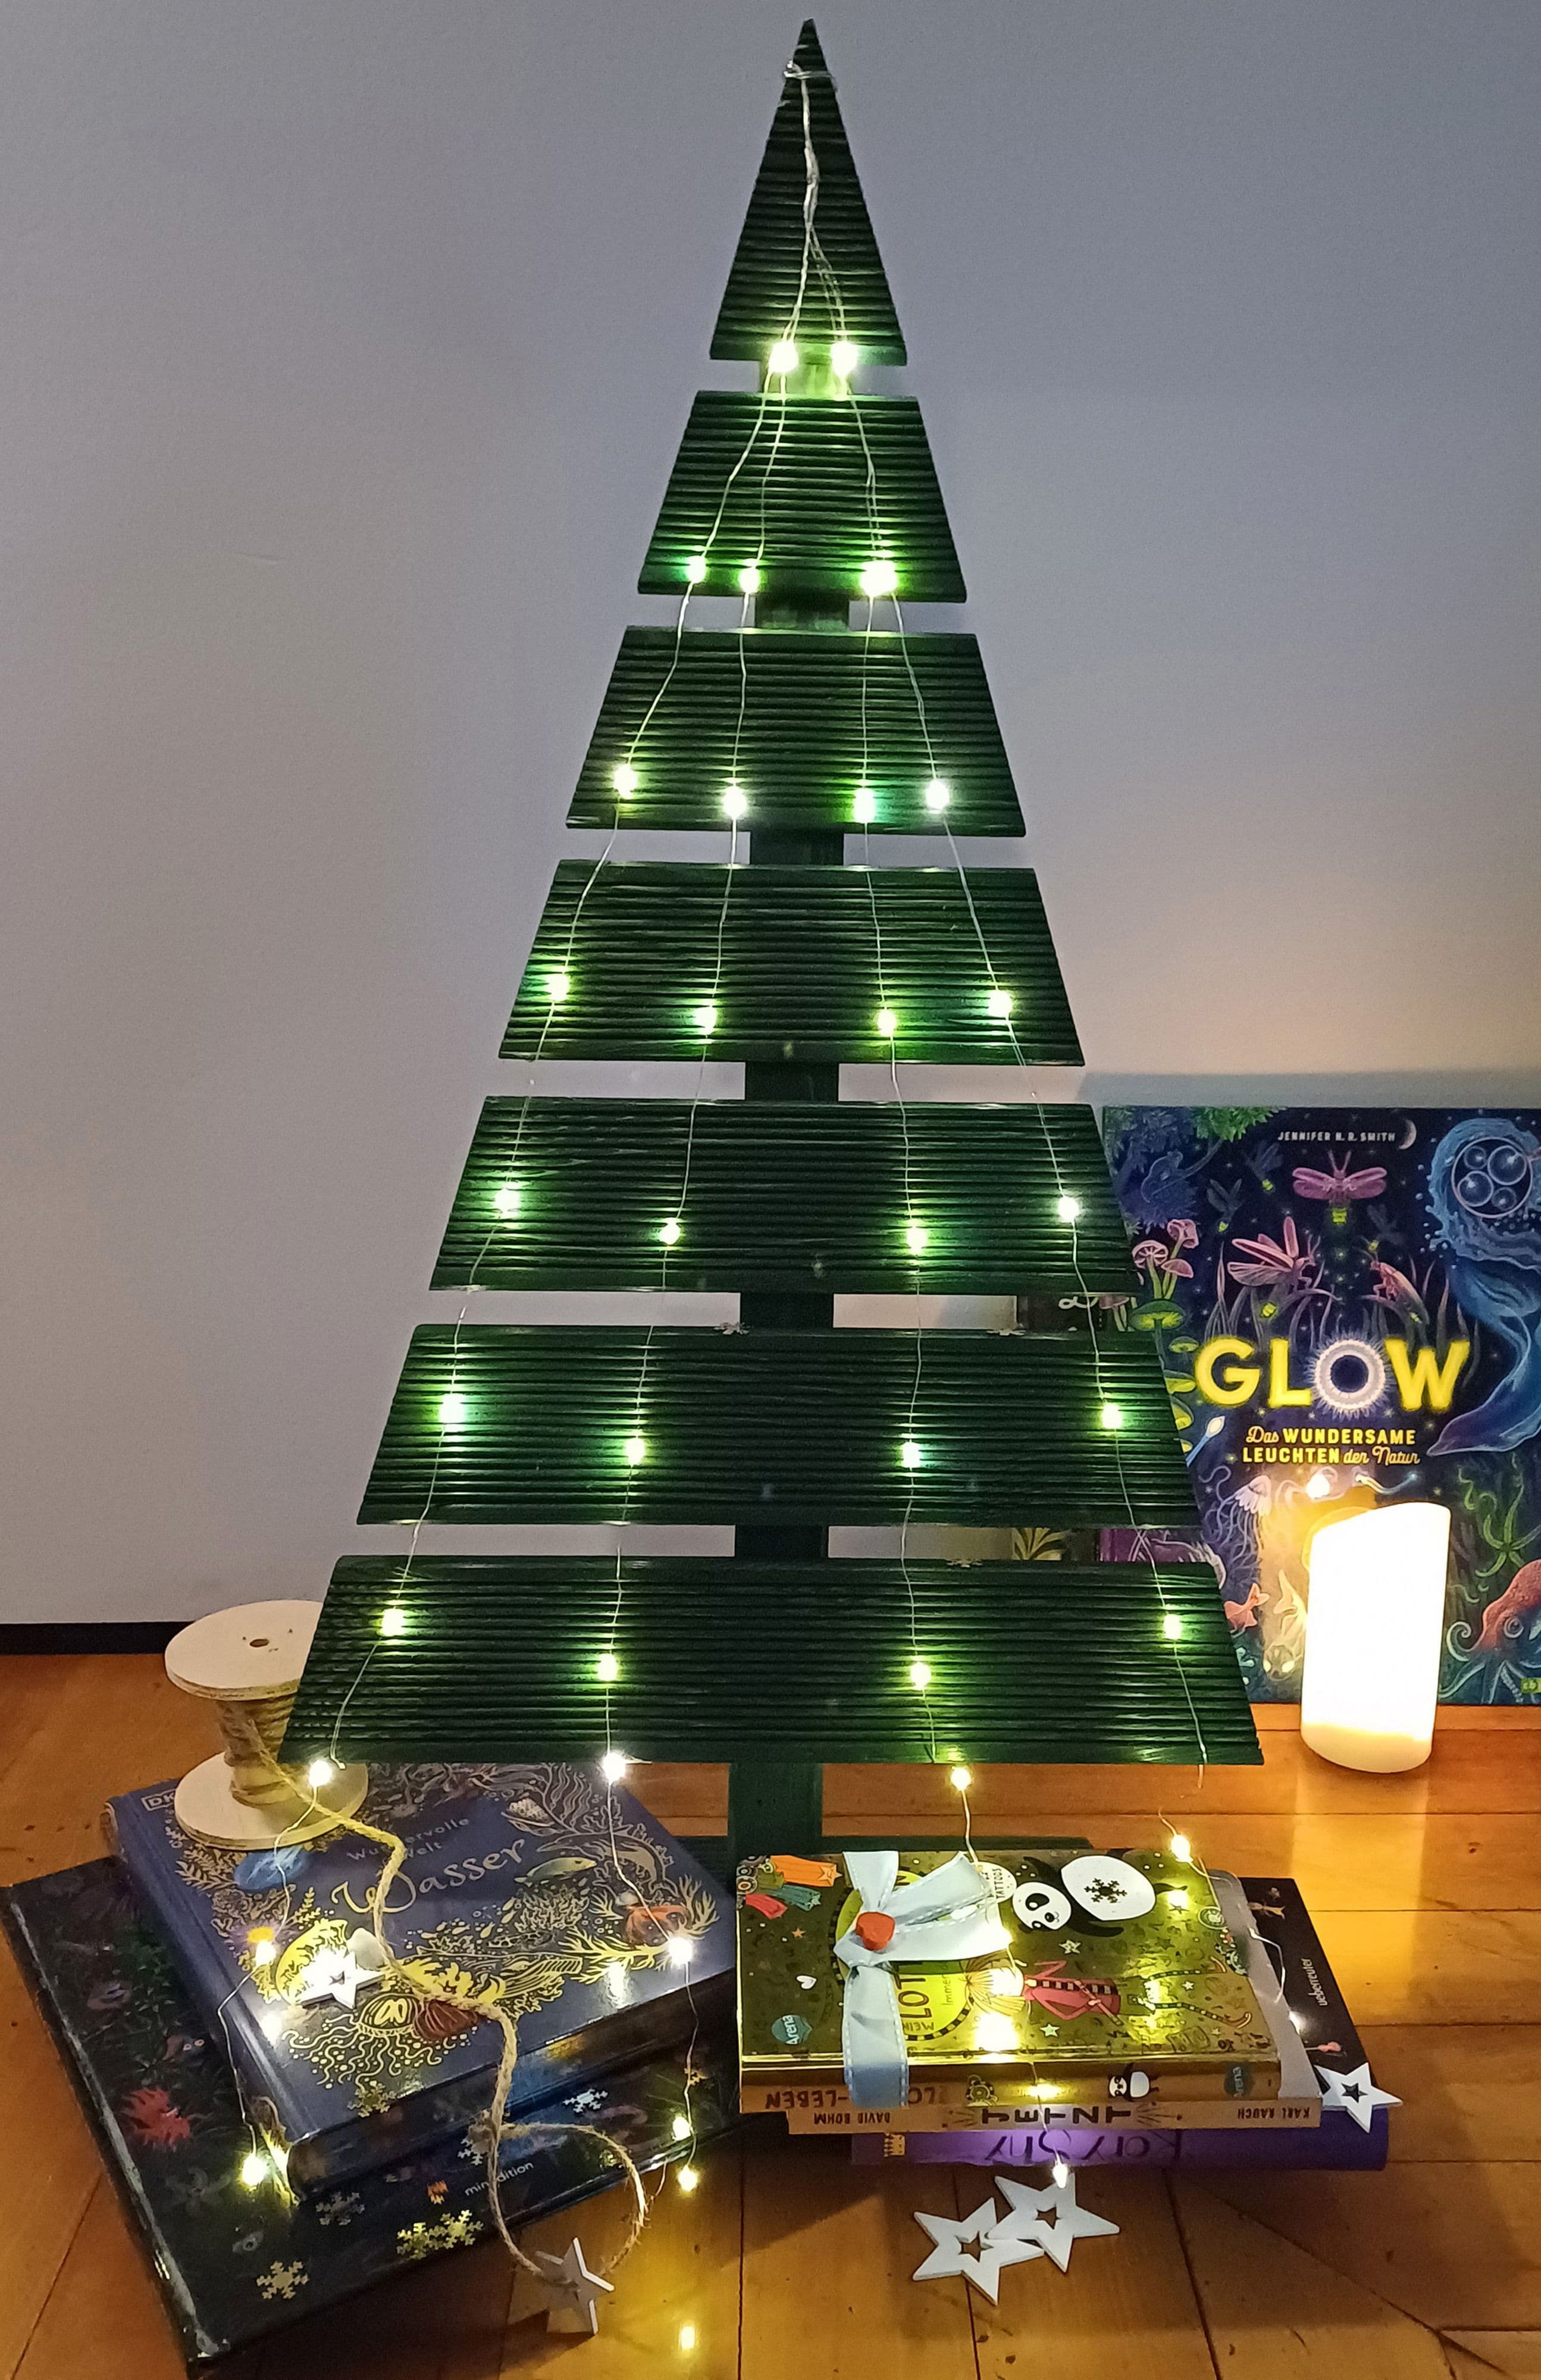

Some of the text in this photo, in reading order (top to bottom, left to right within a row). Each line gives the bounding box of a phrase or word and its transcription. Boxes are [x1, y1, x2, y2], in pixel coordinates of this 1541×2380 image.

[1278, 1132, 1331, 1141] JENNIFER
[1348, 1132, 1358, 1142] R.
[1360, 1132, 1396, 1142] SMITH
[1195, 1337, 1470, 1413] GLOW
[1246, 1426, 1416, 1445] Das WUNDERSAME
[1242, 1445, 1421, 1466] LEUCHTEN der Natur
[148, 1792, 175, 1807] DK
[331, 1838, 525, 1914] Wasser
[992, 1868, 1006, 1899] TATTOOS
[782, 2015, 800, 2045] Arena
[857, 2112, 891, 2124] DAVID
[1237, 2107, 1311, 2119] KARL RAUCH
[464, 2162, 534, 2197] mindition
